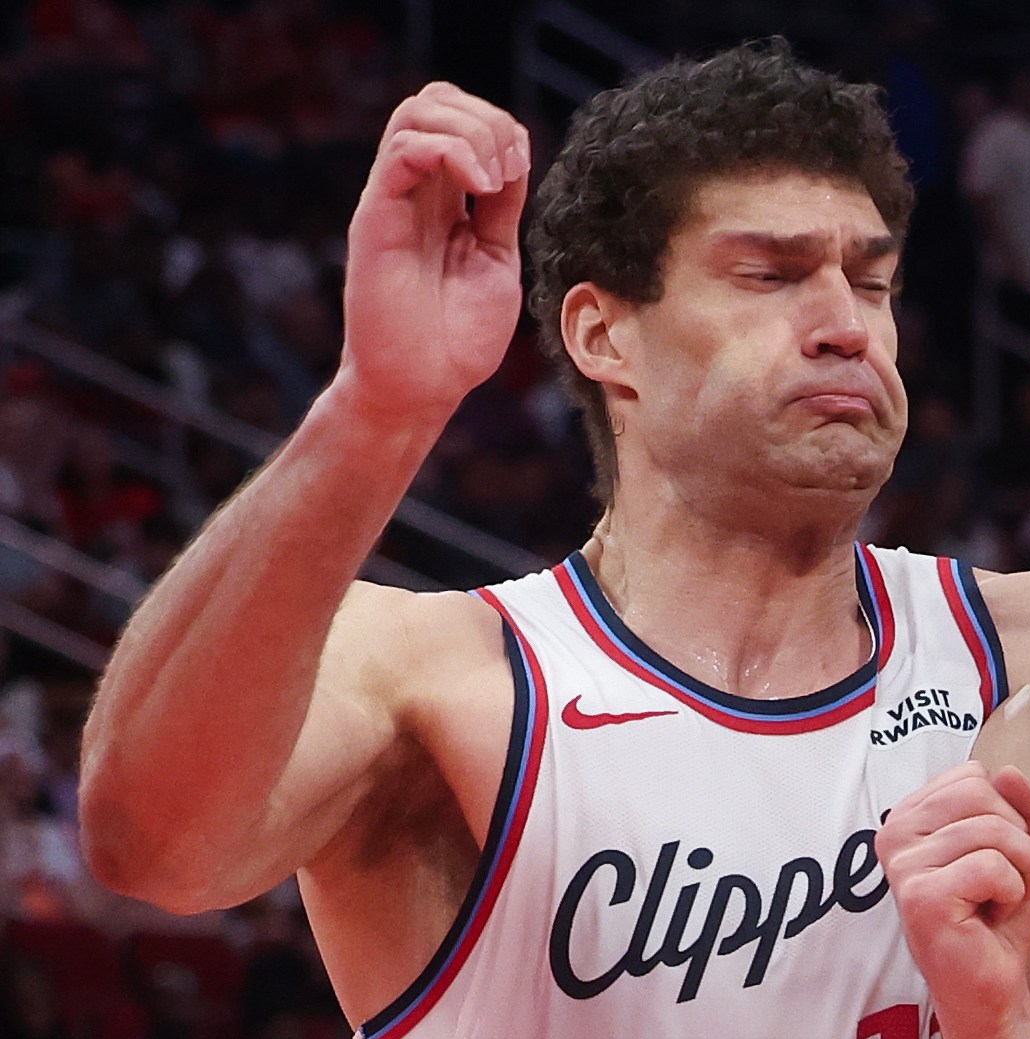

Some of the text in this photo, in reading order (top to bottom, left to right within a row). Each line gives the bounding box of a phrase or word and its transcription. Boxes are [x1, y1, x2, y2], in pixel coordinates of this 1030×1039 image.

[887, 689, 950, 721] VISIT
[870, 708, 978, 746] RWANDA
[549, 808, 892, 1004] Clippe
